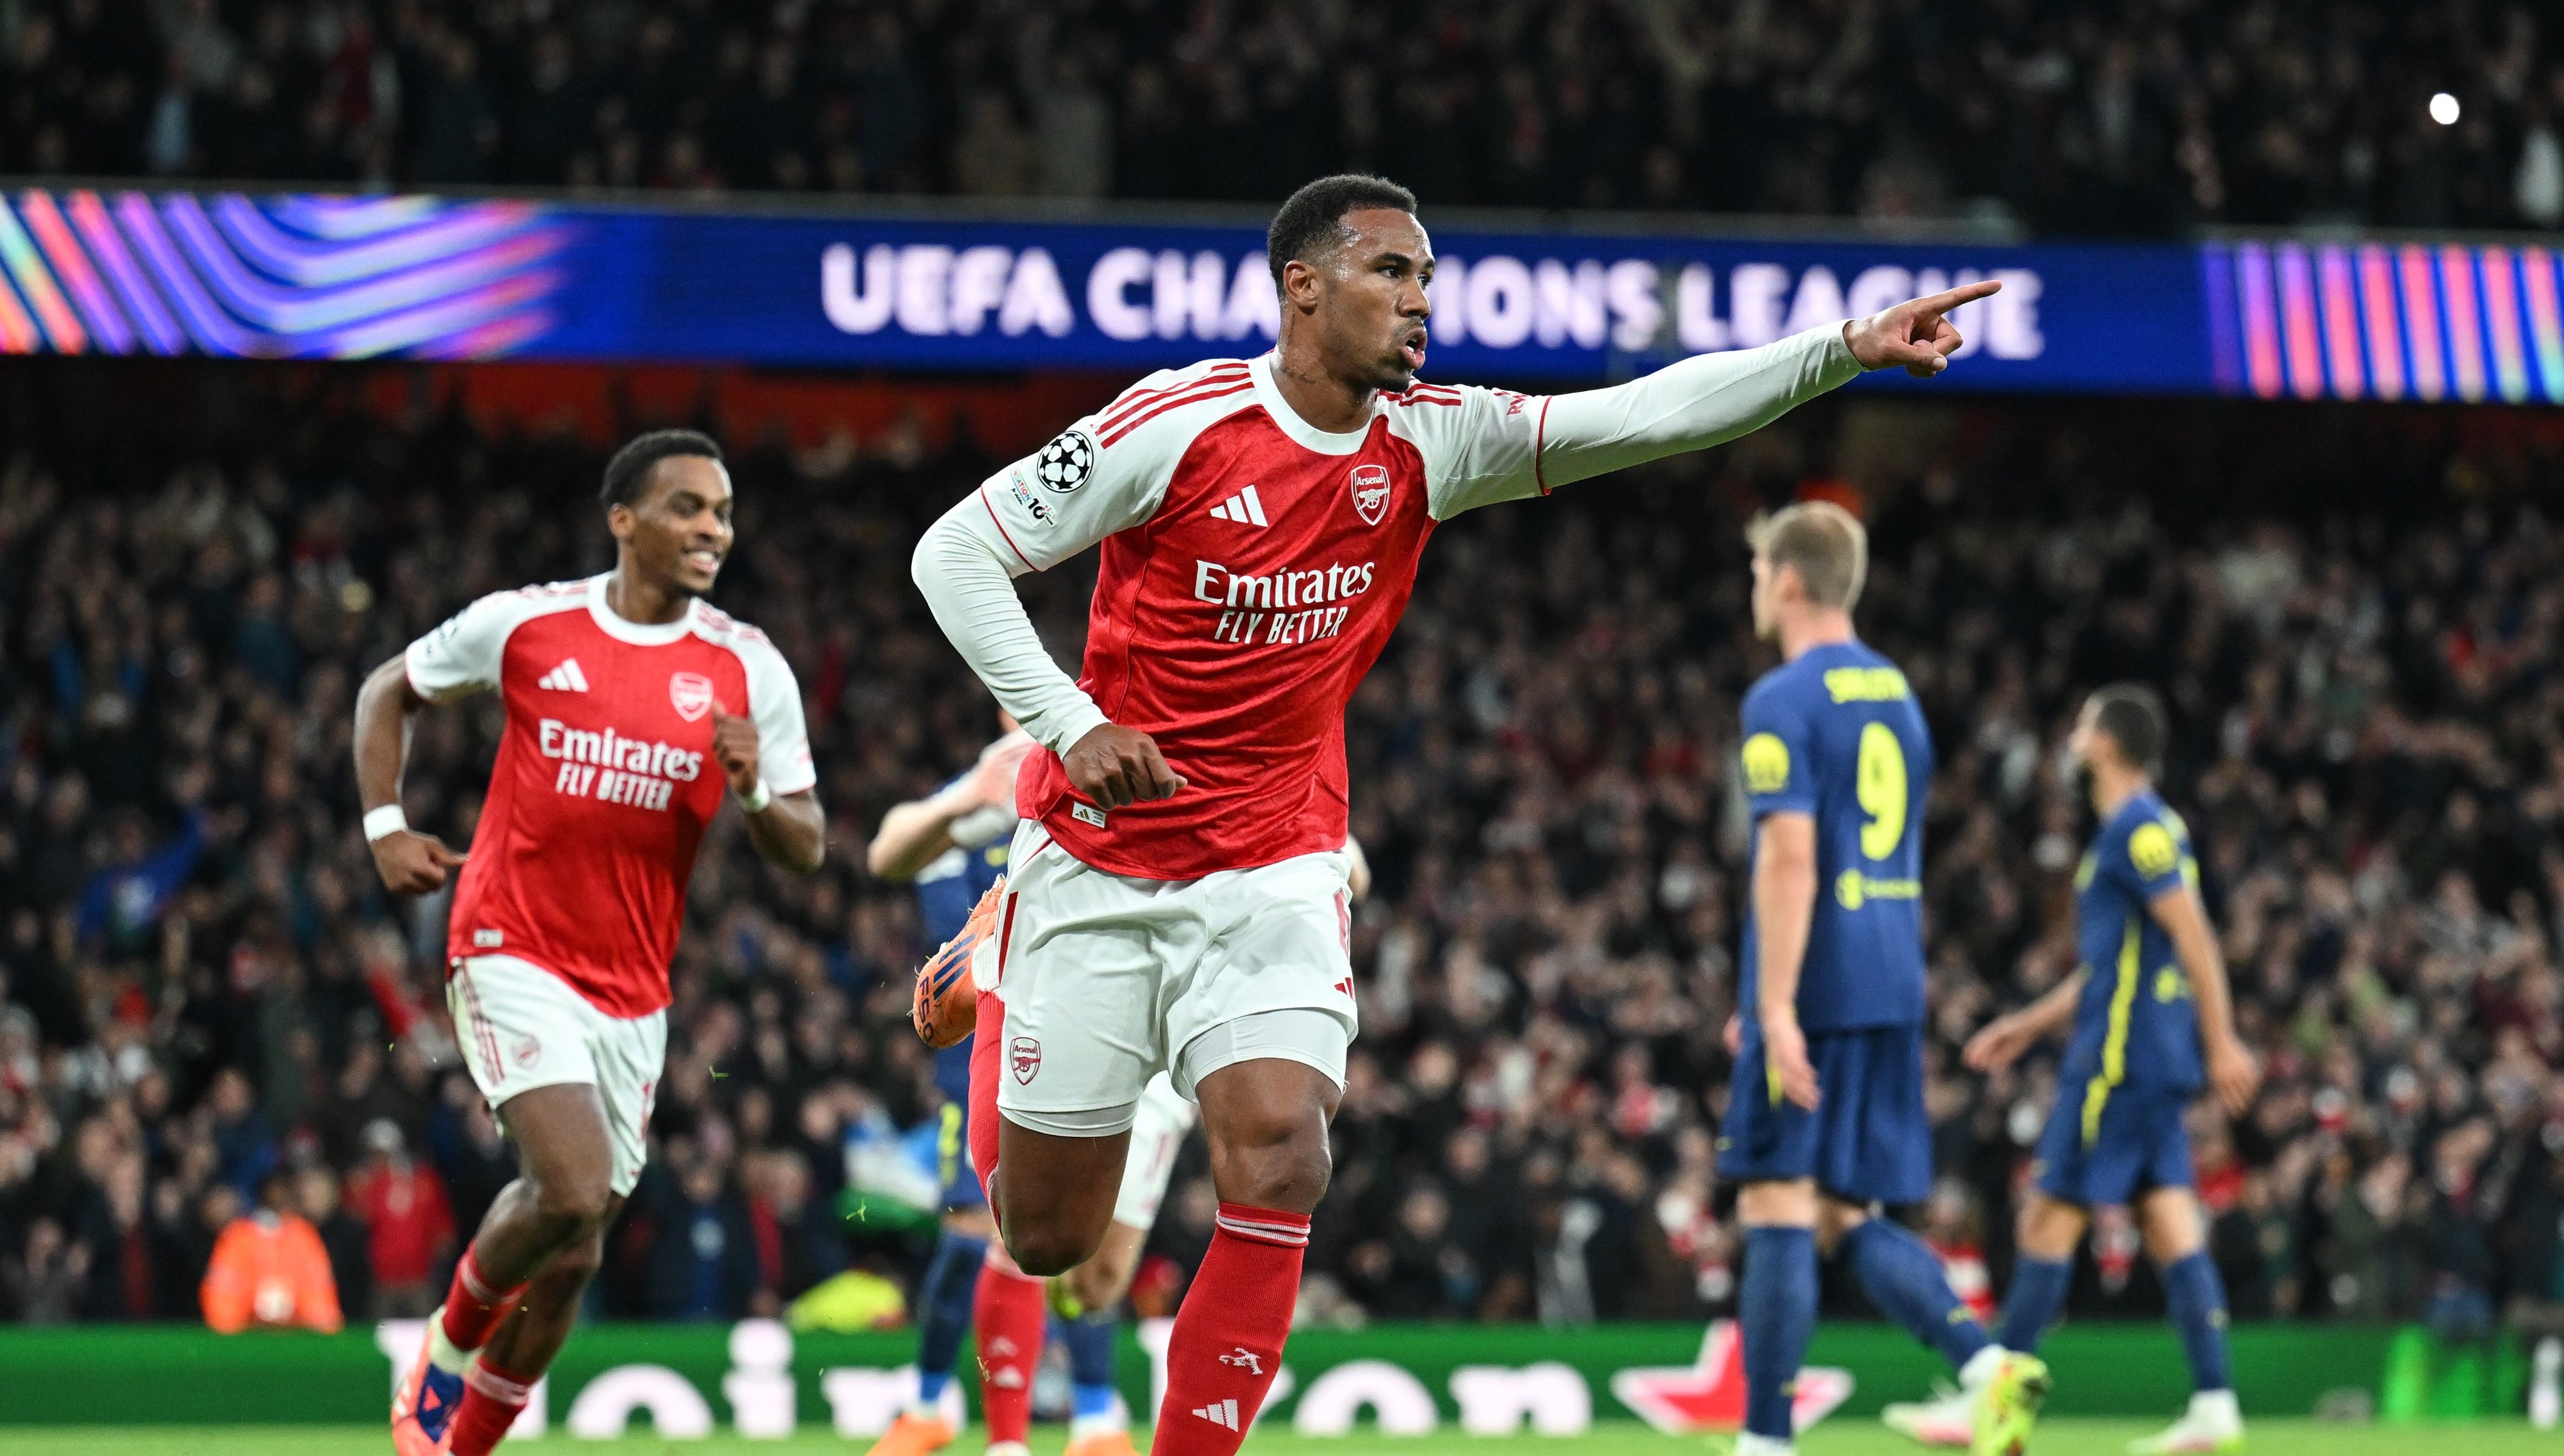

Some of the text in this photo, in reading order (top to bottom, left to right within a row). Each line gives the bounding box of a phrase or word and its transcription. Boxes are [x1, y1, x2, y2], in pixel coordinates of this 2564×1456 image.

[823, 244, 1074, 337] UEFA
[1084, 249, 1666, 352] CHAIONS
[1357, 474, 1384, 486] Arsenal
[1195, 560, 1375, 608] Emirates
[1214, 606, 1348, 644] FLY BETTER
[539, 718, 703, 782] Emirates
[555, 761, 674, 812] FLY BETTER
[1857, 721, 1908, 861] 9
[1014, 1045, 1036, 1054] Arsenal
